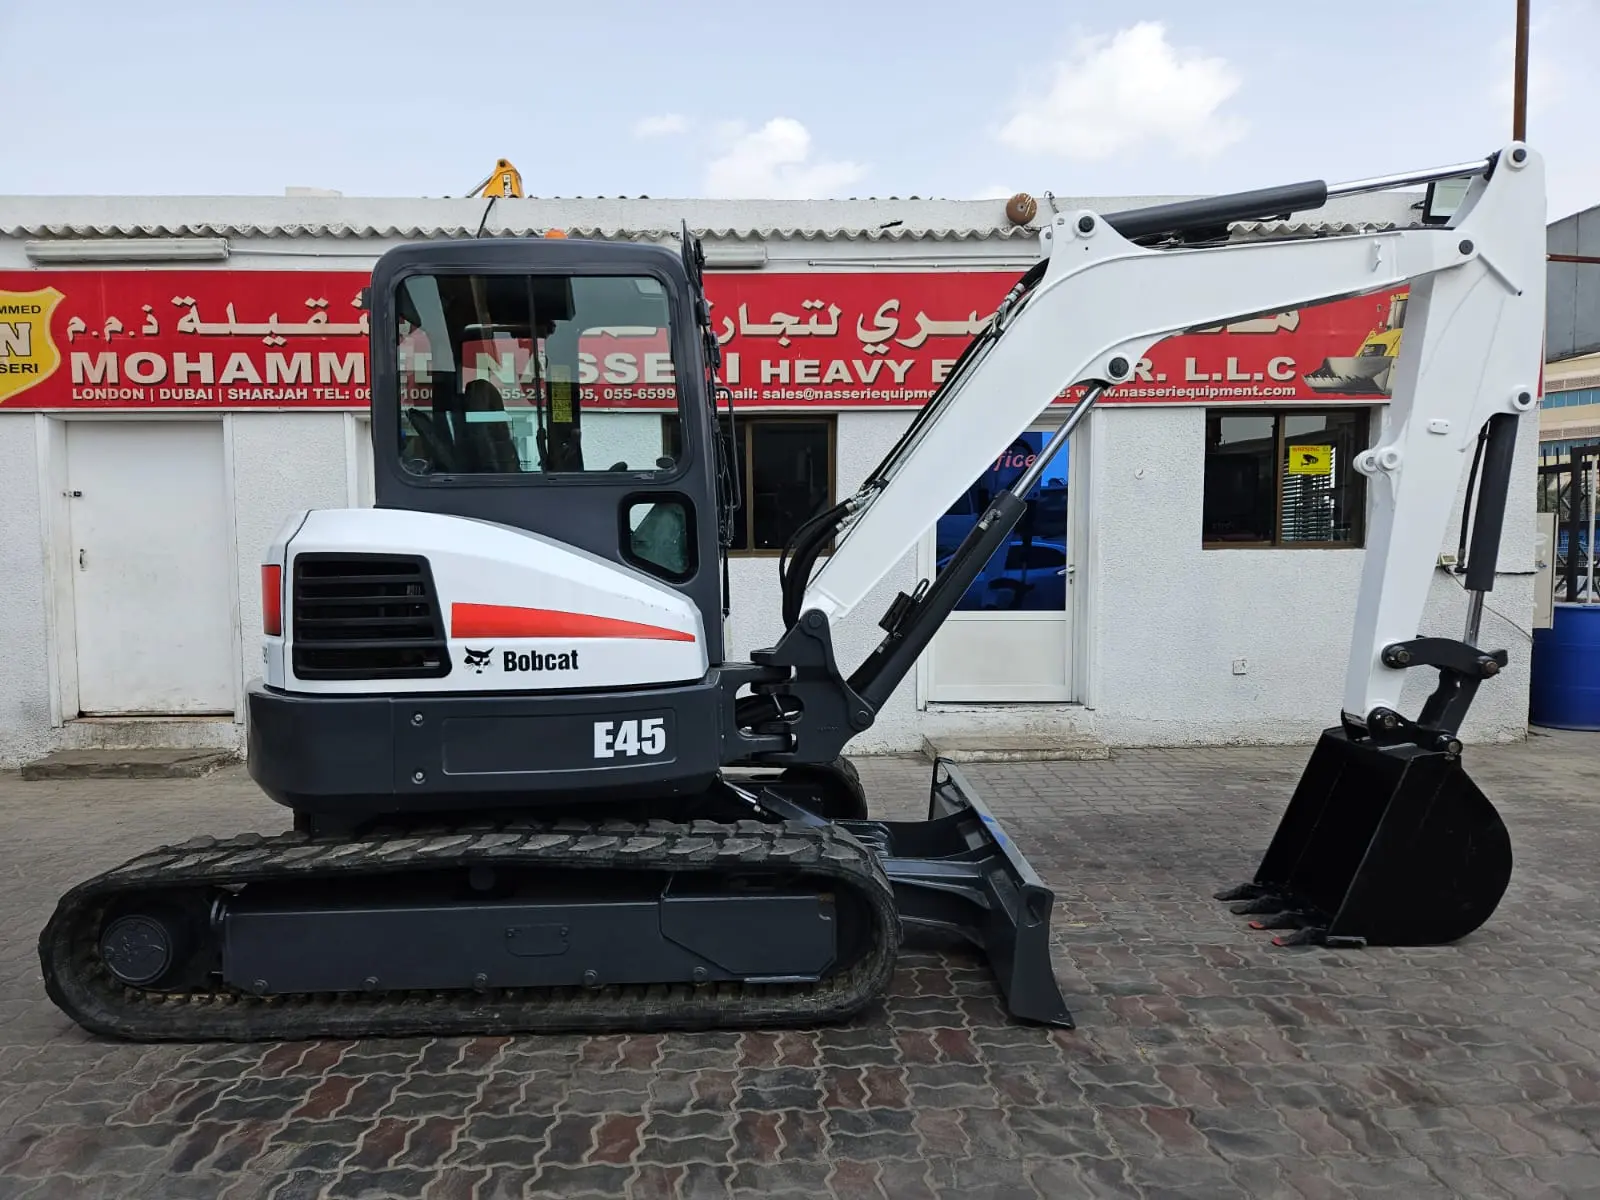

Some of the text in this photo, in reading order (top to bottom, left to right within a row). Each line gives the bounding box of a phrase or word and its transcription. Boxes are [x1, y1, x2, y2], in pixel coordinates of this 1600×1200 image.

[761, 359, 915, 384] HEAVY
[1185, 356, 1296, 381] L.L.C
[72, 388, 144, 400] LONDON
[160, 388, 213, 400] DUBAI
[228, 388, 308, 401] SHARJAH
[313, 388, 350, 400] TEL:
[503, 650, 579, 672] Bobcat
[593, 717, 666, 759] E45
